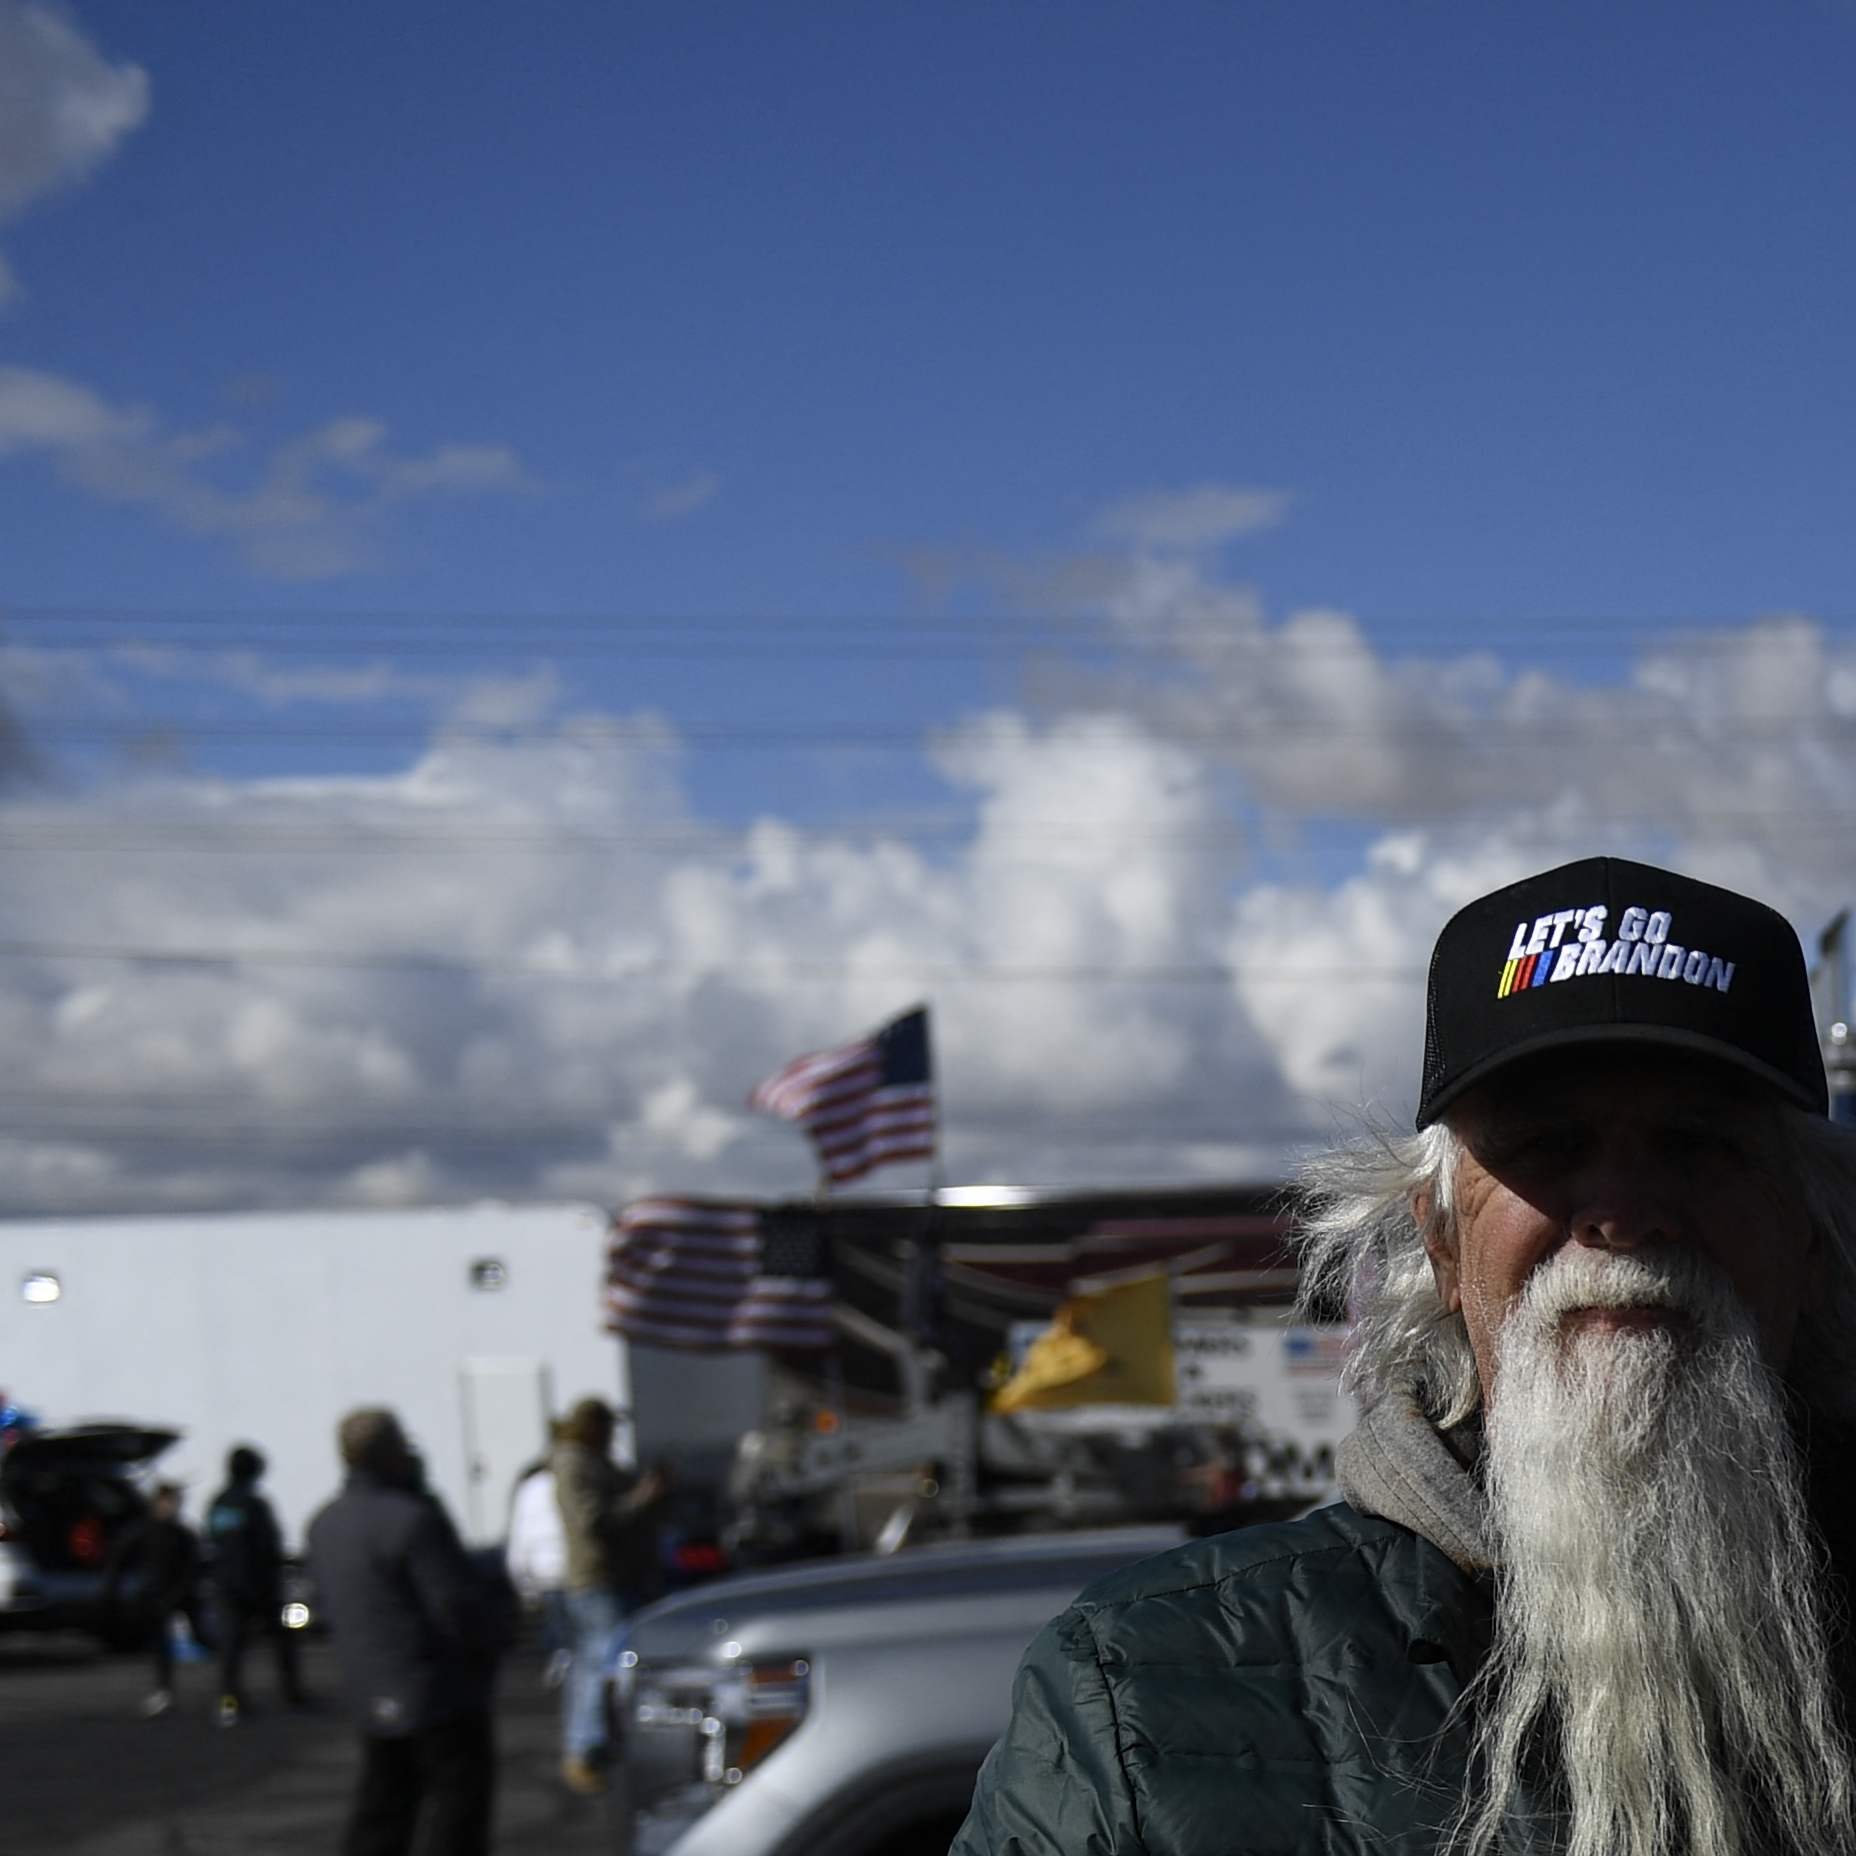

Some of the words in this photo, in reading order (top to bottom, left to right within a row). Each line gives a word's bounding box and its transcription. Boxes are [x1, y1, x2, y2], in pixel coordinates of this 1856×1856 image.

[1508, 904, 1608, 960] LET'S
[1619, 905, 1672, 945] GO
[1550, 939, 1736, 993] BRANDON
